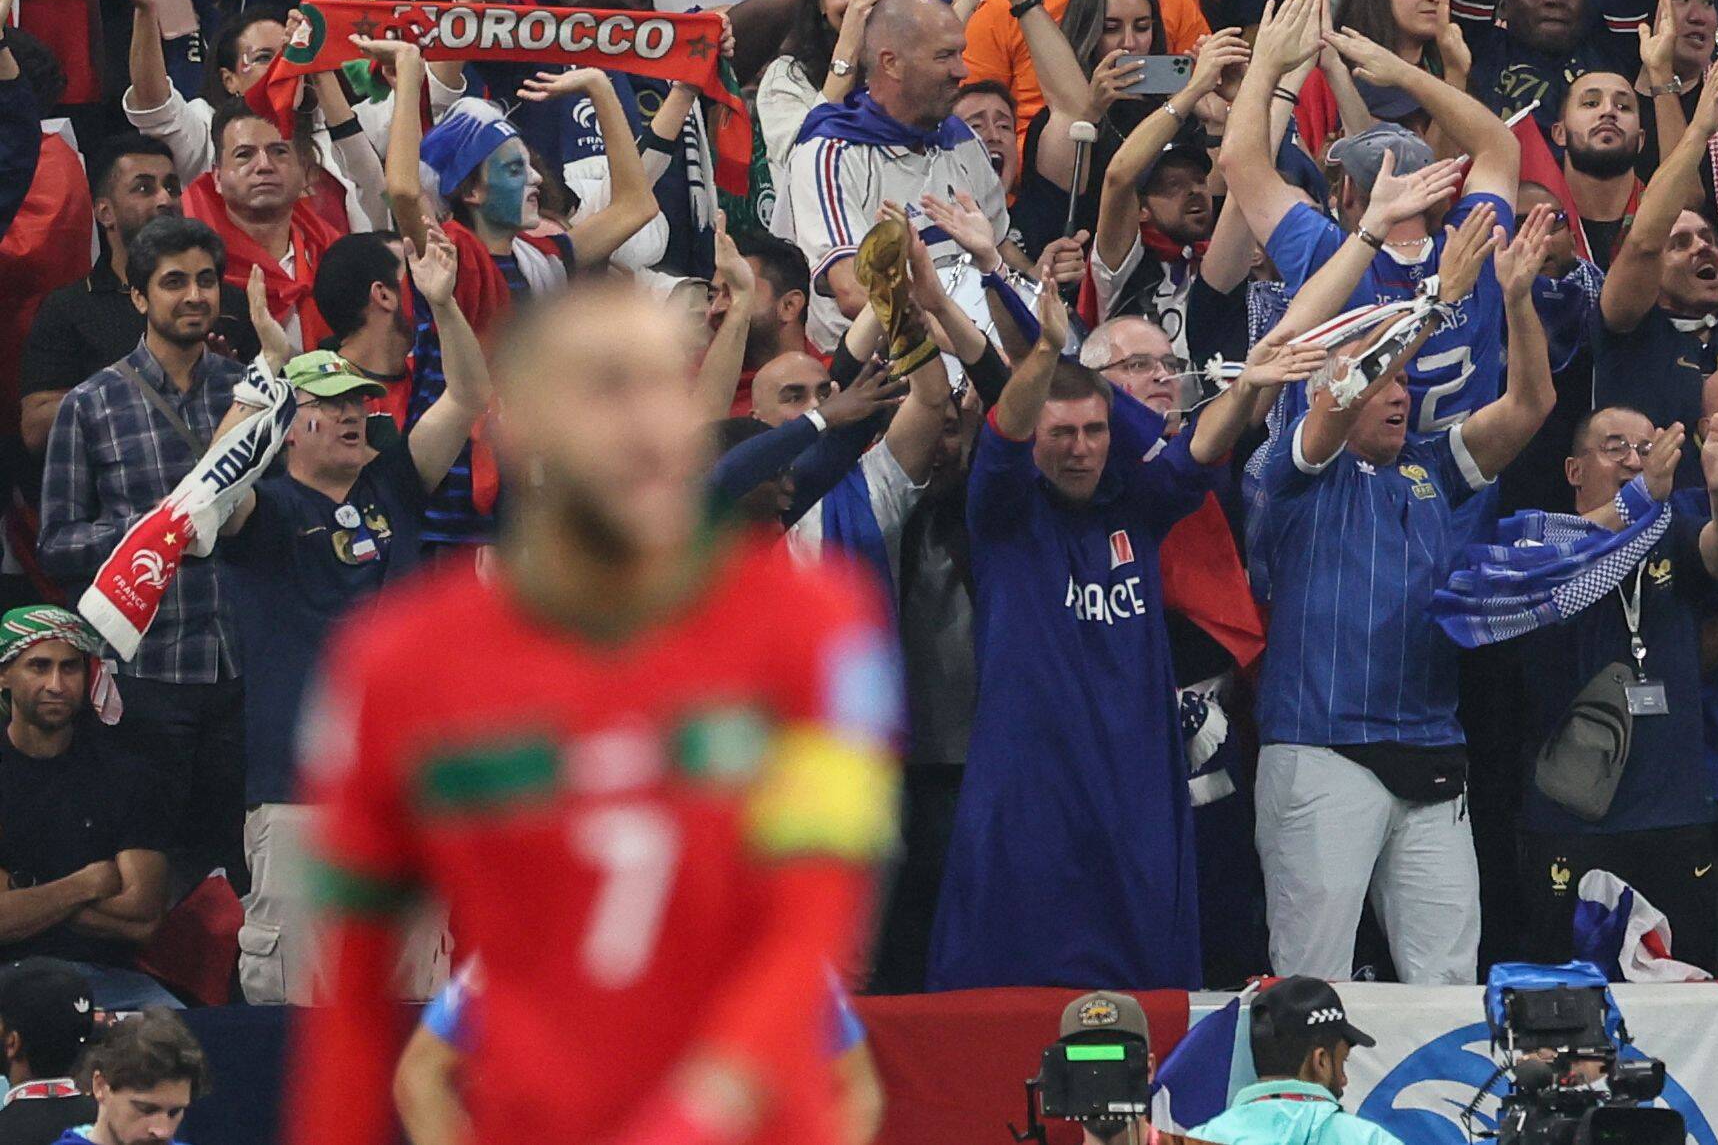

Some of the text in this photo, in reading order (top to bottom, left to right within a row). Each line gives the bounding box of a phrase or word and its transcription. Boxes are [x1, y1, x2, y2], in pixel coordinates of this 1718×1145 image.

[418, 5, 678, 61] OROCCO
[1415, 343, 1477, 435] 2
[112, 574, 150, 613] FRANCE
